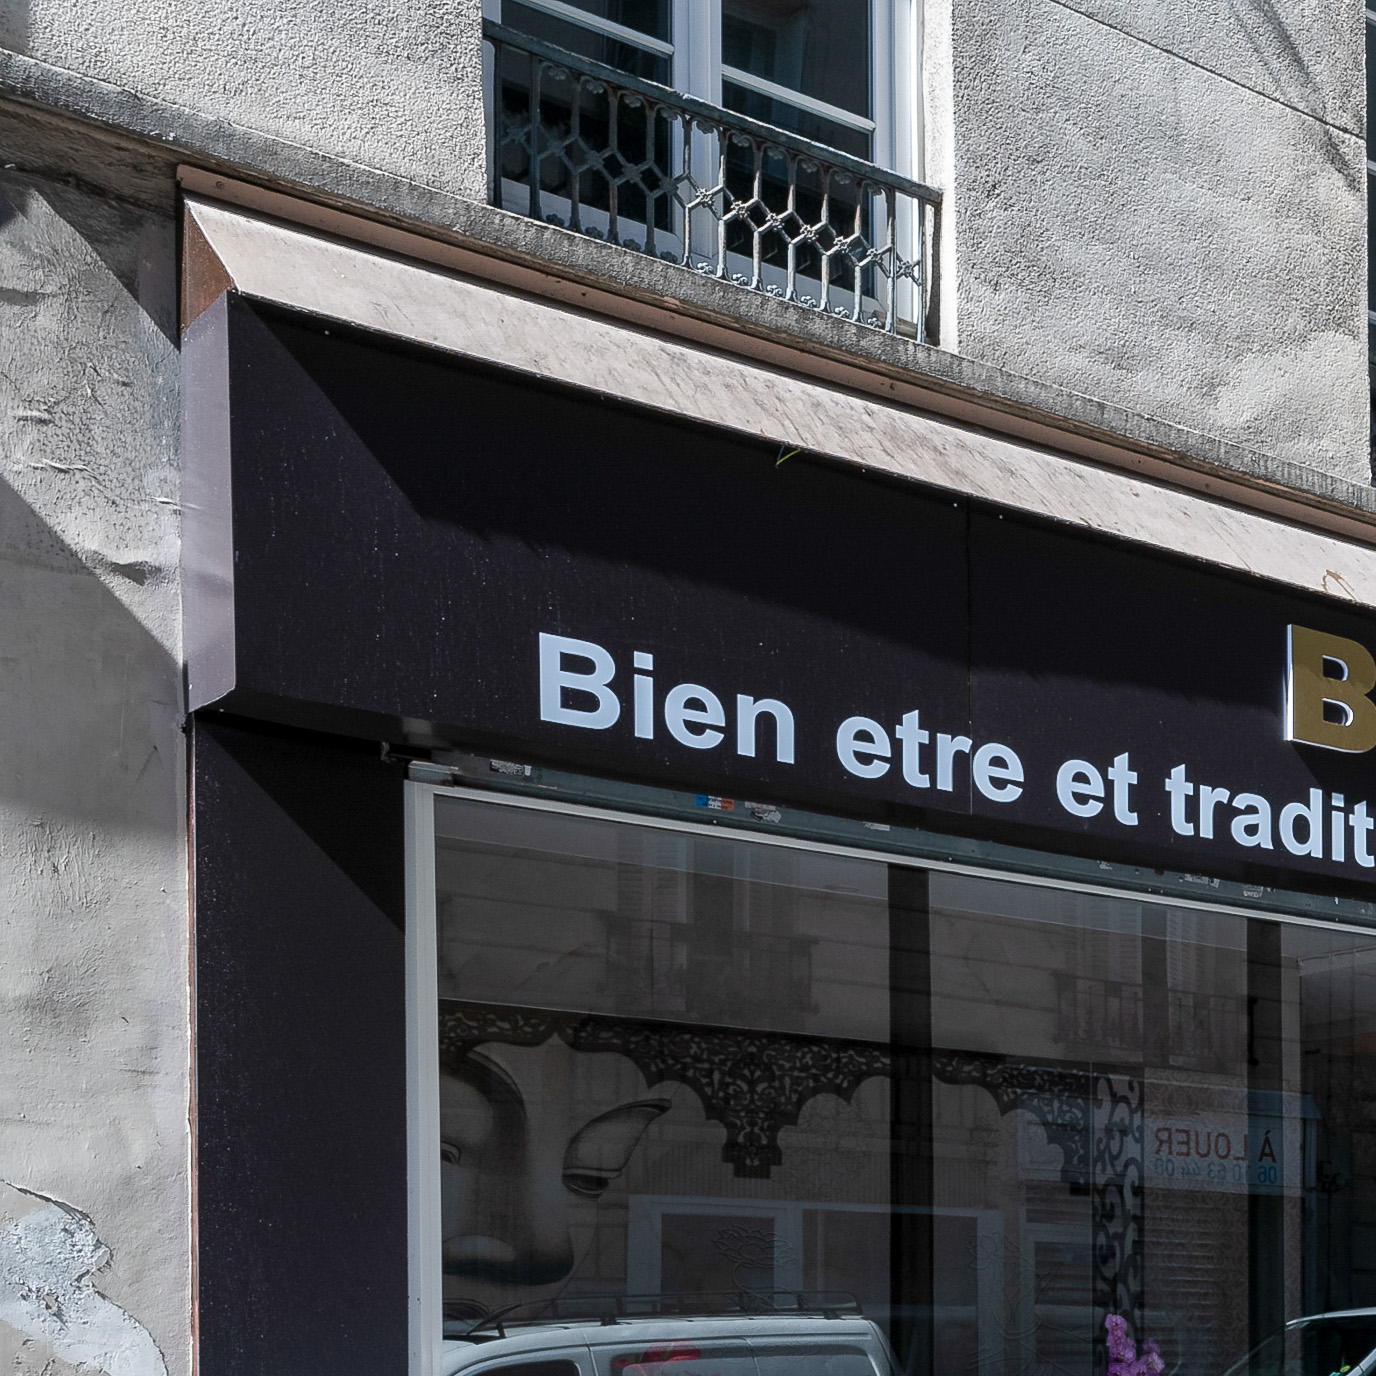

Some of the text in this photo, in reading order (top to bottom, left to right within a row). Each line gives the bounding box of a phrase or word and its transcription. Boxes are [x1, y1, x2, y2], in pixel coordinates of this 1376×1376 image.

[539, 632, 795, 765] Bien
[836, 709, 1025, 802] etre
[1056, 752, 1140, 826] et
